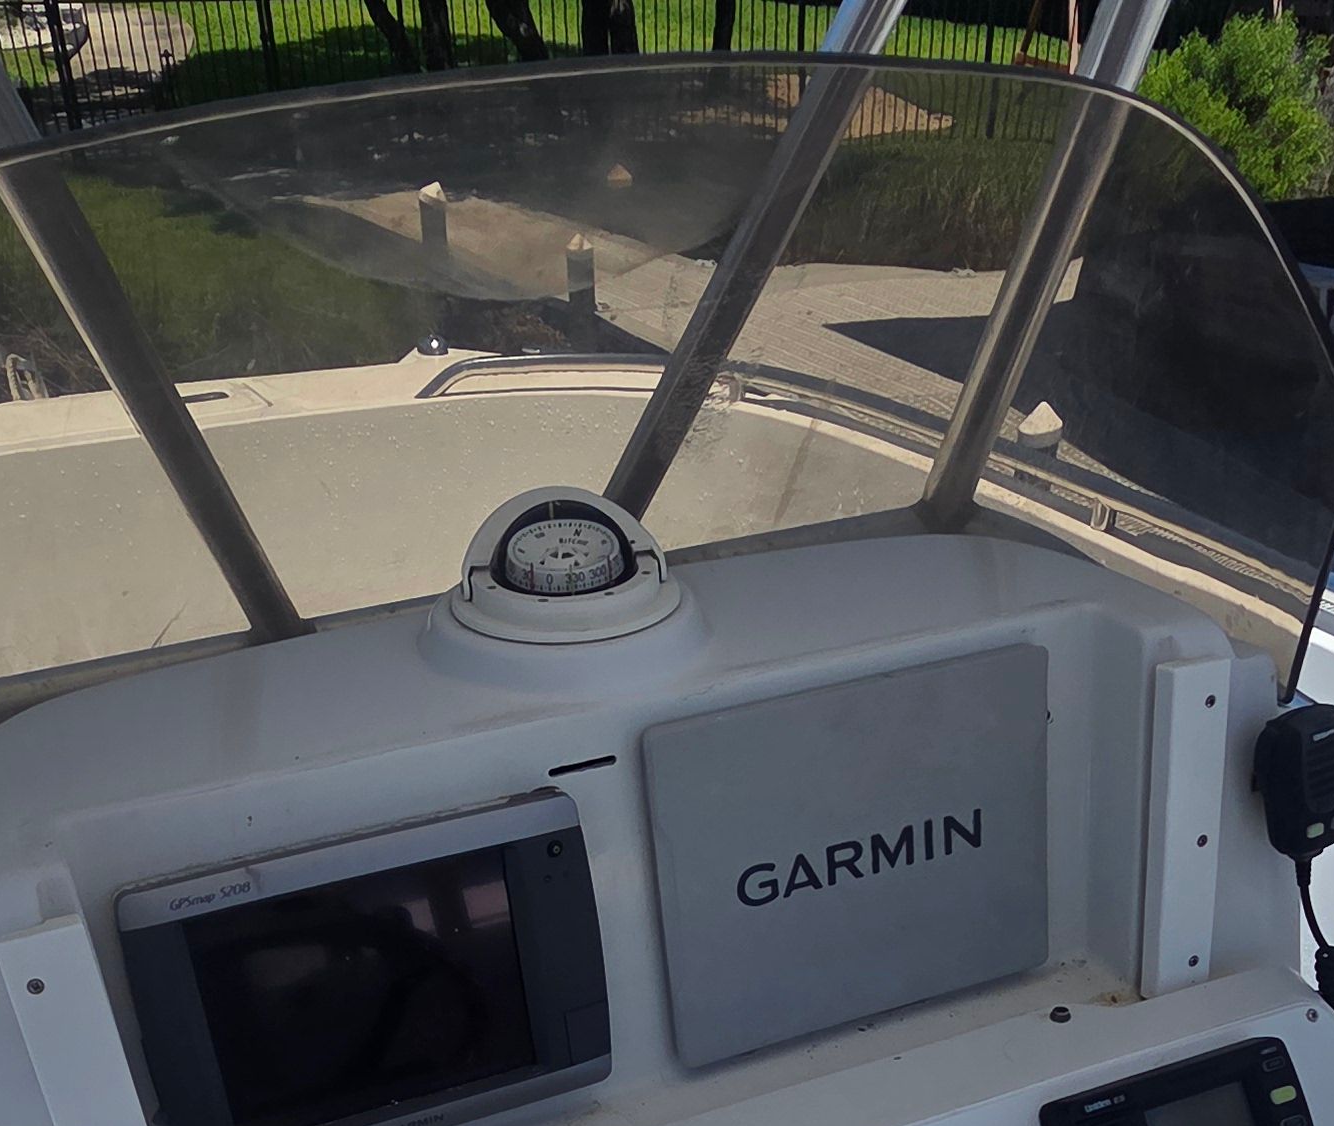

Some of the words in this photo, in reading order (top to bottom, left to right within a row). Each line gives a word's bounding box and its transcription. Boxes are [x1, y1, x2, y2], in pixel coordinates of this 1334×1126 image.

[573, 528, 583, 537] N
[565, 571, 586, 584] 330
[588, 564, 607, 578] 300
[736, 808, 982, 907] GARMIN
[220, 881, 252, 898] 5208
